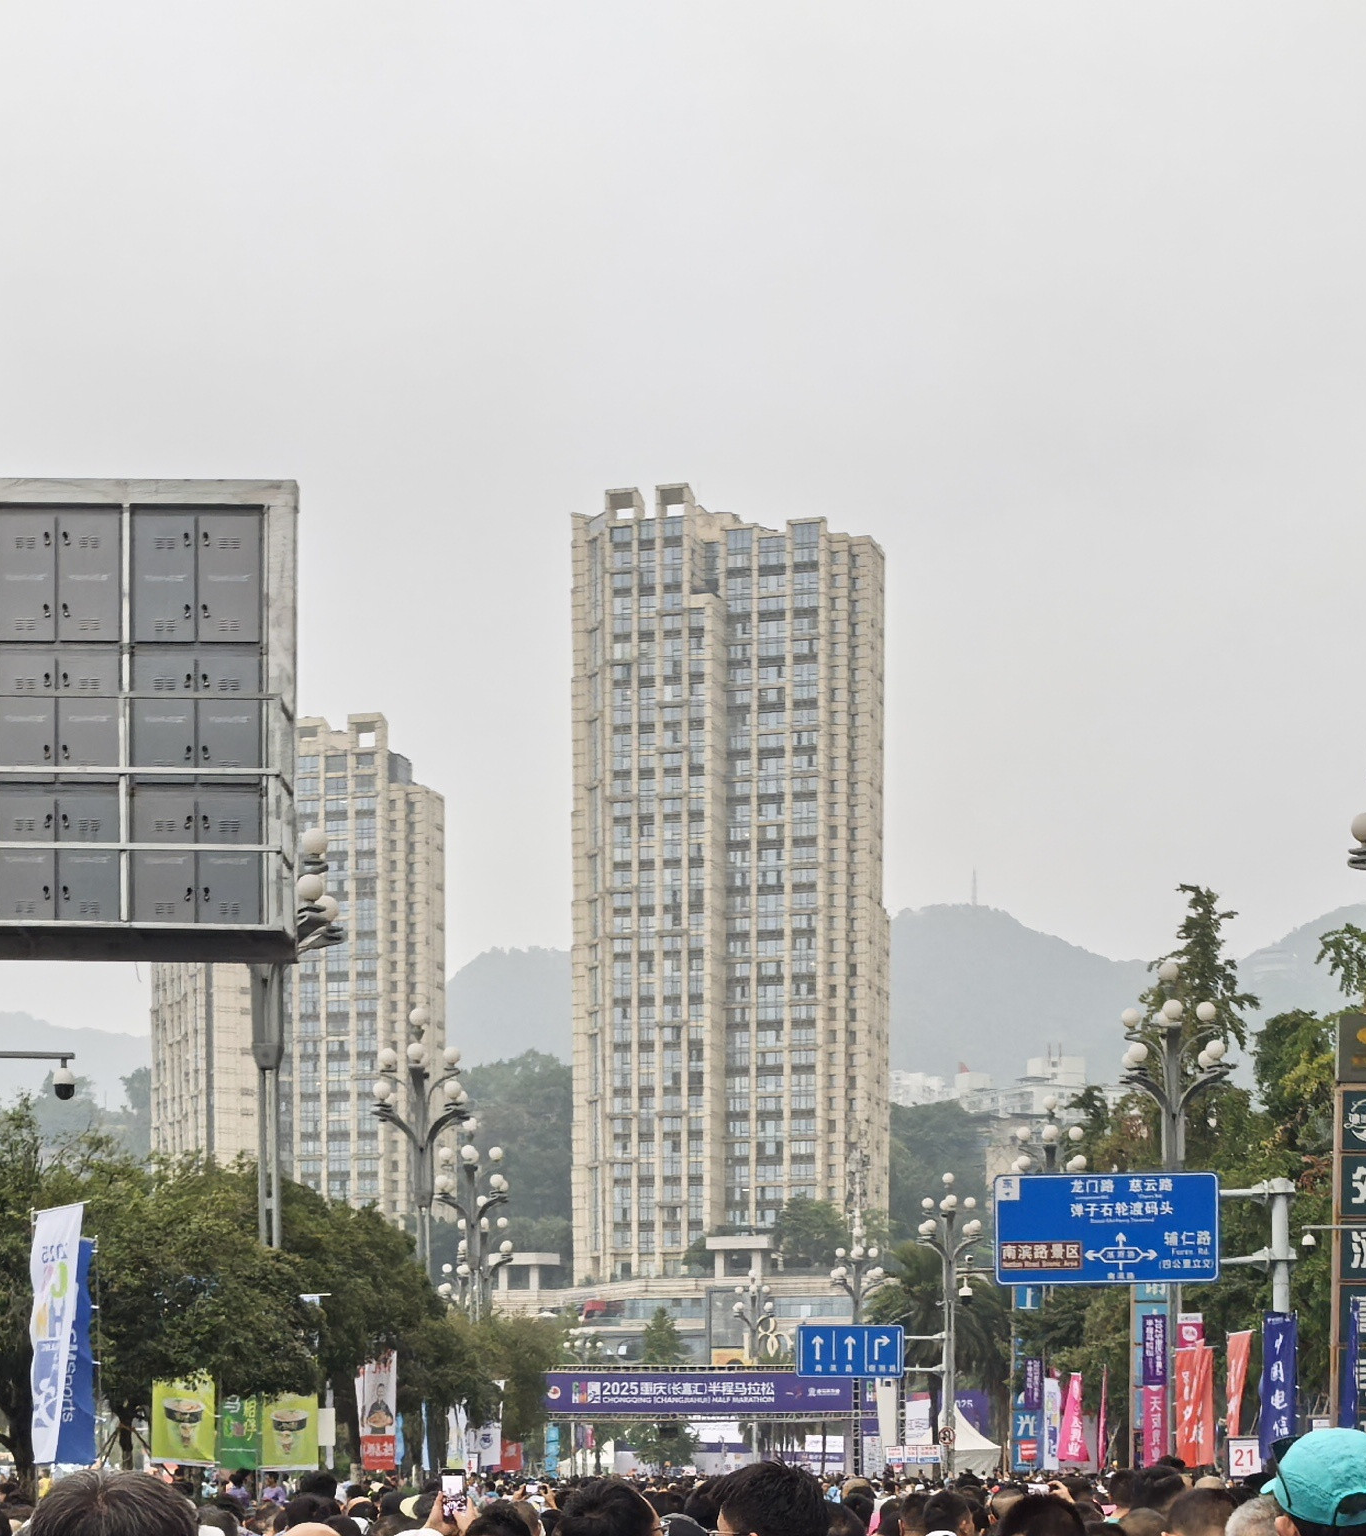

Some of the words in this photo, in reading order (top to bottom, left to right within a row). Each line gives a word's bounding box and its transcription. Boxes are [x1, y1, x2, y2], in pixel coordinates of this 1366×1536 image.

[1070, 1178, 1115, 1194] 龙门路
[1128, 1178, 1174, 1193] 慈云路
[1070, 1201, 1174, 1218] 弹子石轮渡码头
[1163, 1230, 1212, 1247] 辅仁路
[1001, 1243, 1081, 1261] 南滨路景区
[1234, 1448, 1255, 1467] 21
